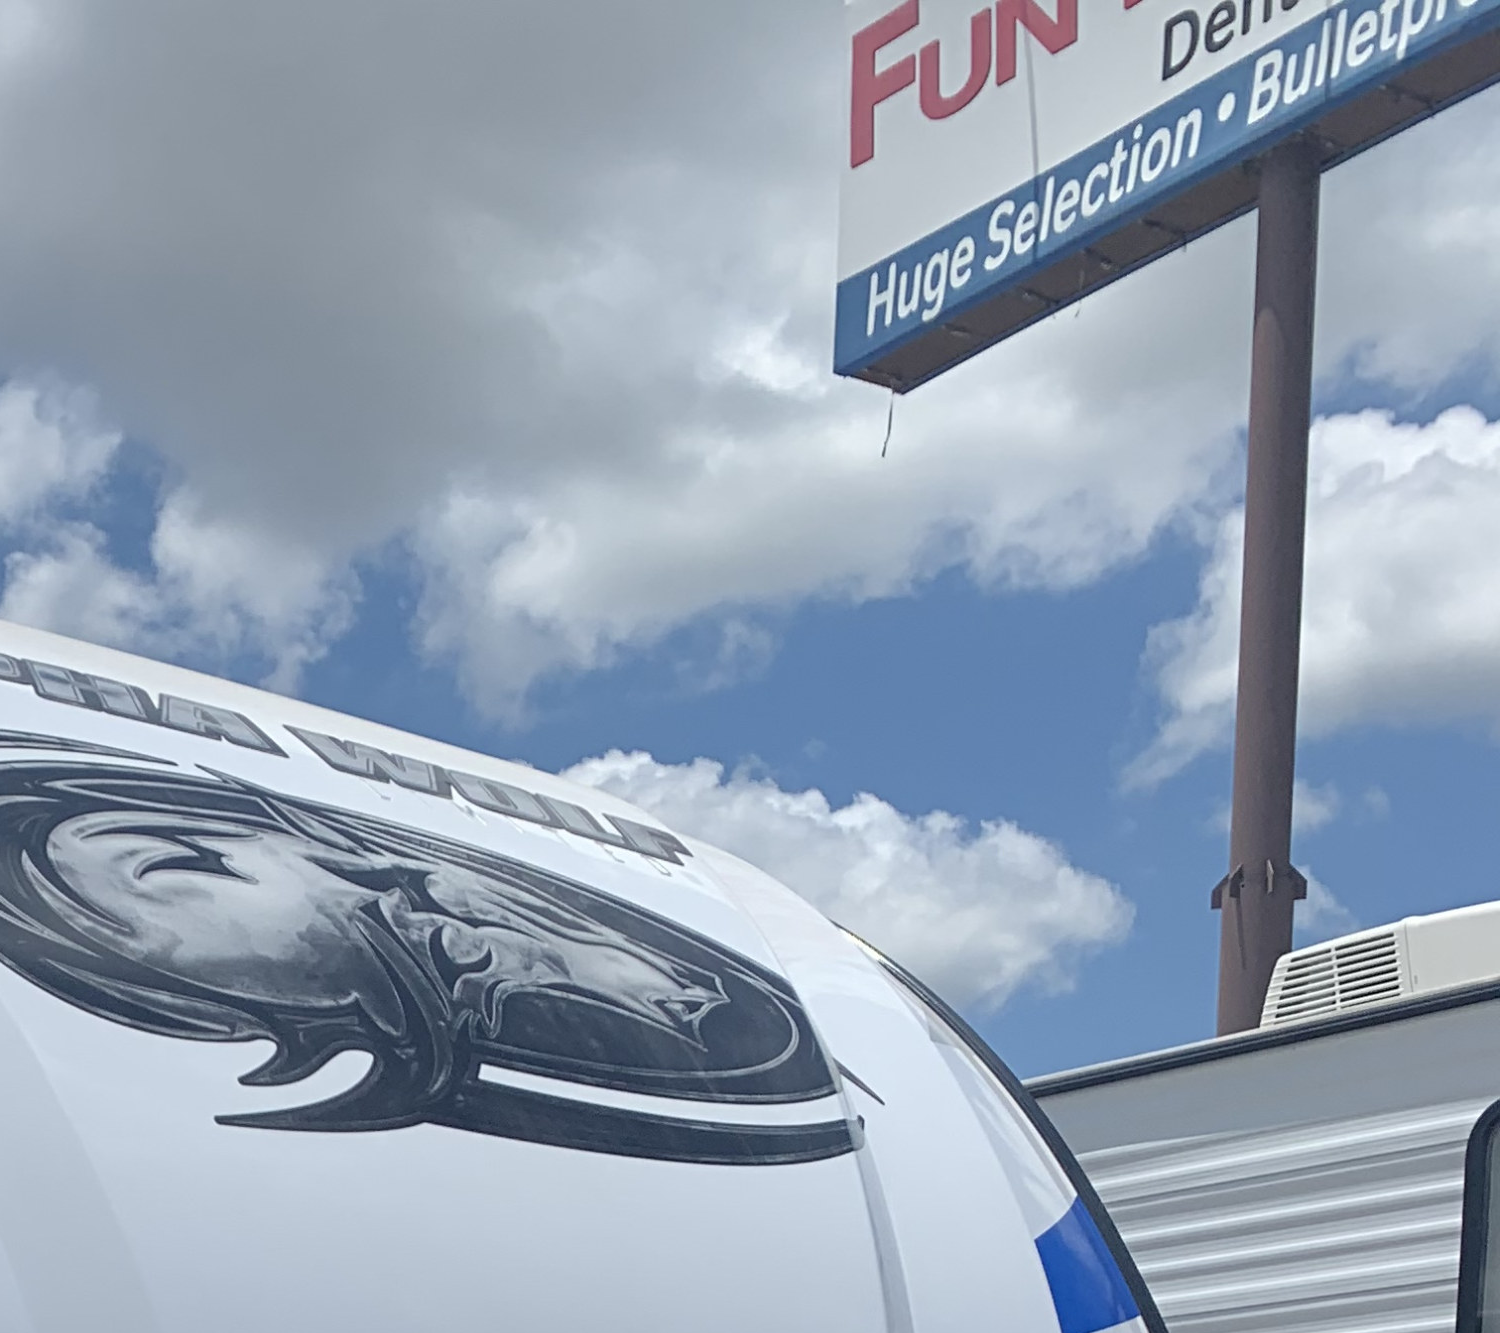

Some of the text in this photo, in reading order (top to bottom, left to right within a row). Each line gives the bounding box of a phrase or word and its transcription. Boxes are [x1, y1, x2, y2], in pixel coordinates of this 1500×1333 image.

[850, 0, 1078, 169] FUN
[1162, 0, 1299, 81] Den
[866, 0, 1478, 337] Huge Selection Bulletp
[284, 723, 693, 867] WOLF
